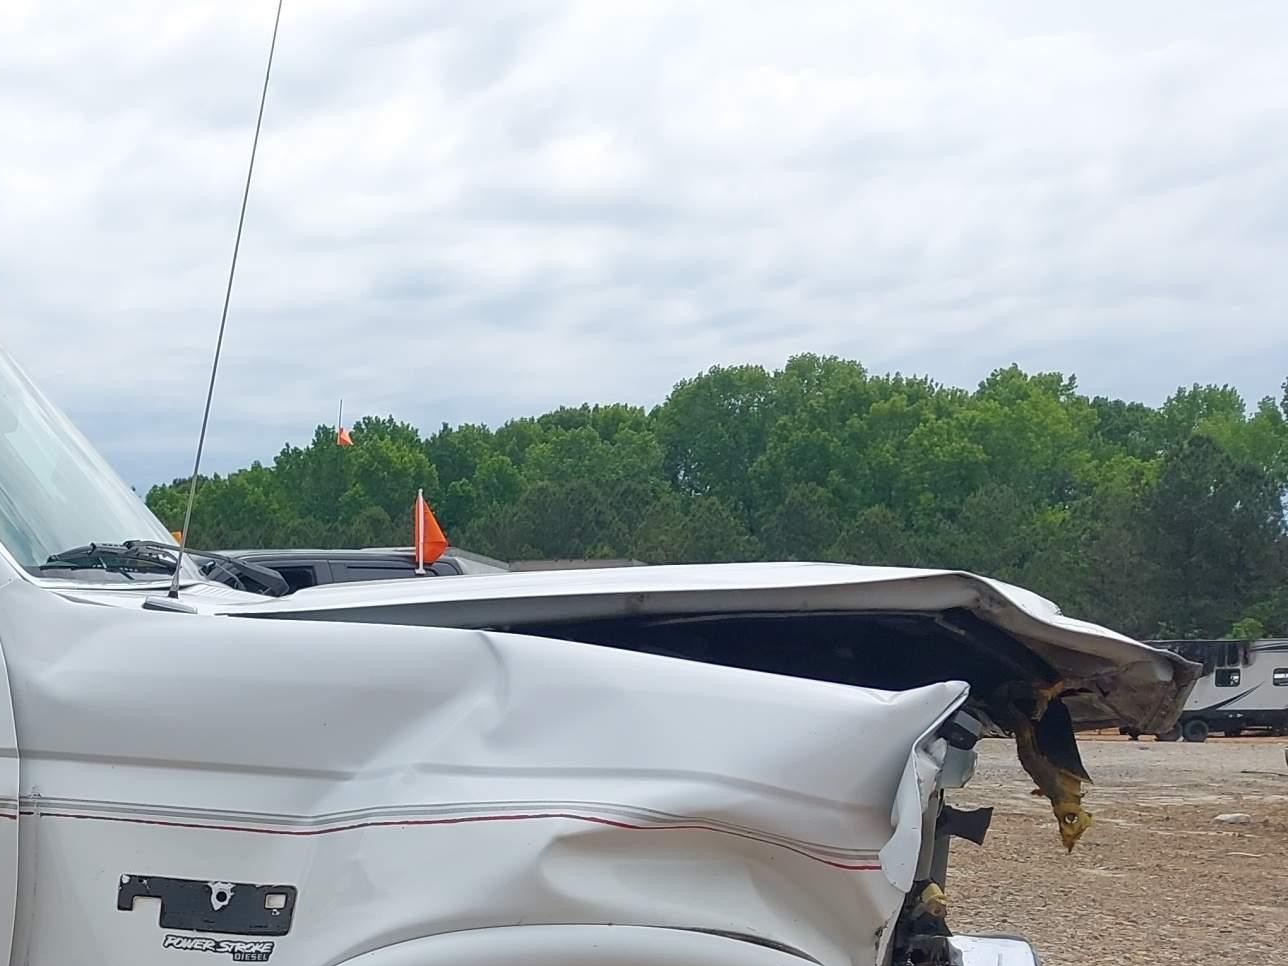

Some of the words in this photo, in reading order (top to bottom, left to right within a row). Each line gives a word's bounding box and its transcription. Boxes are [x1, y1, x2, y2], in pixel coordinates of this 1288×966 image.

[164, 935, 216, 951] POWER
[216, 941, 274, 953] STROKE
[234, 953, 268, 961] DIESEL
